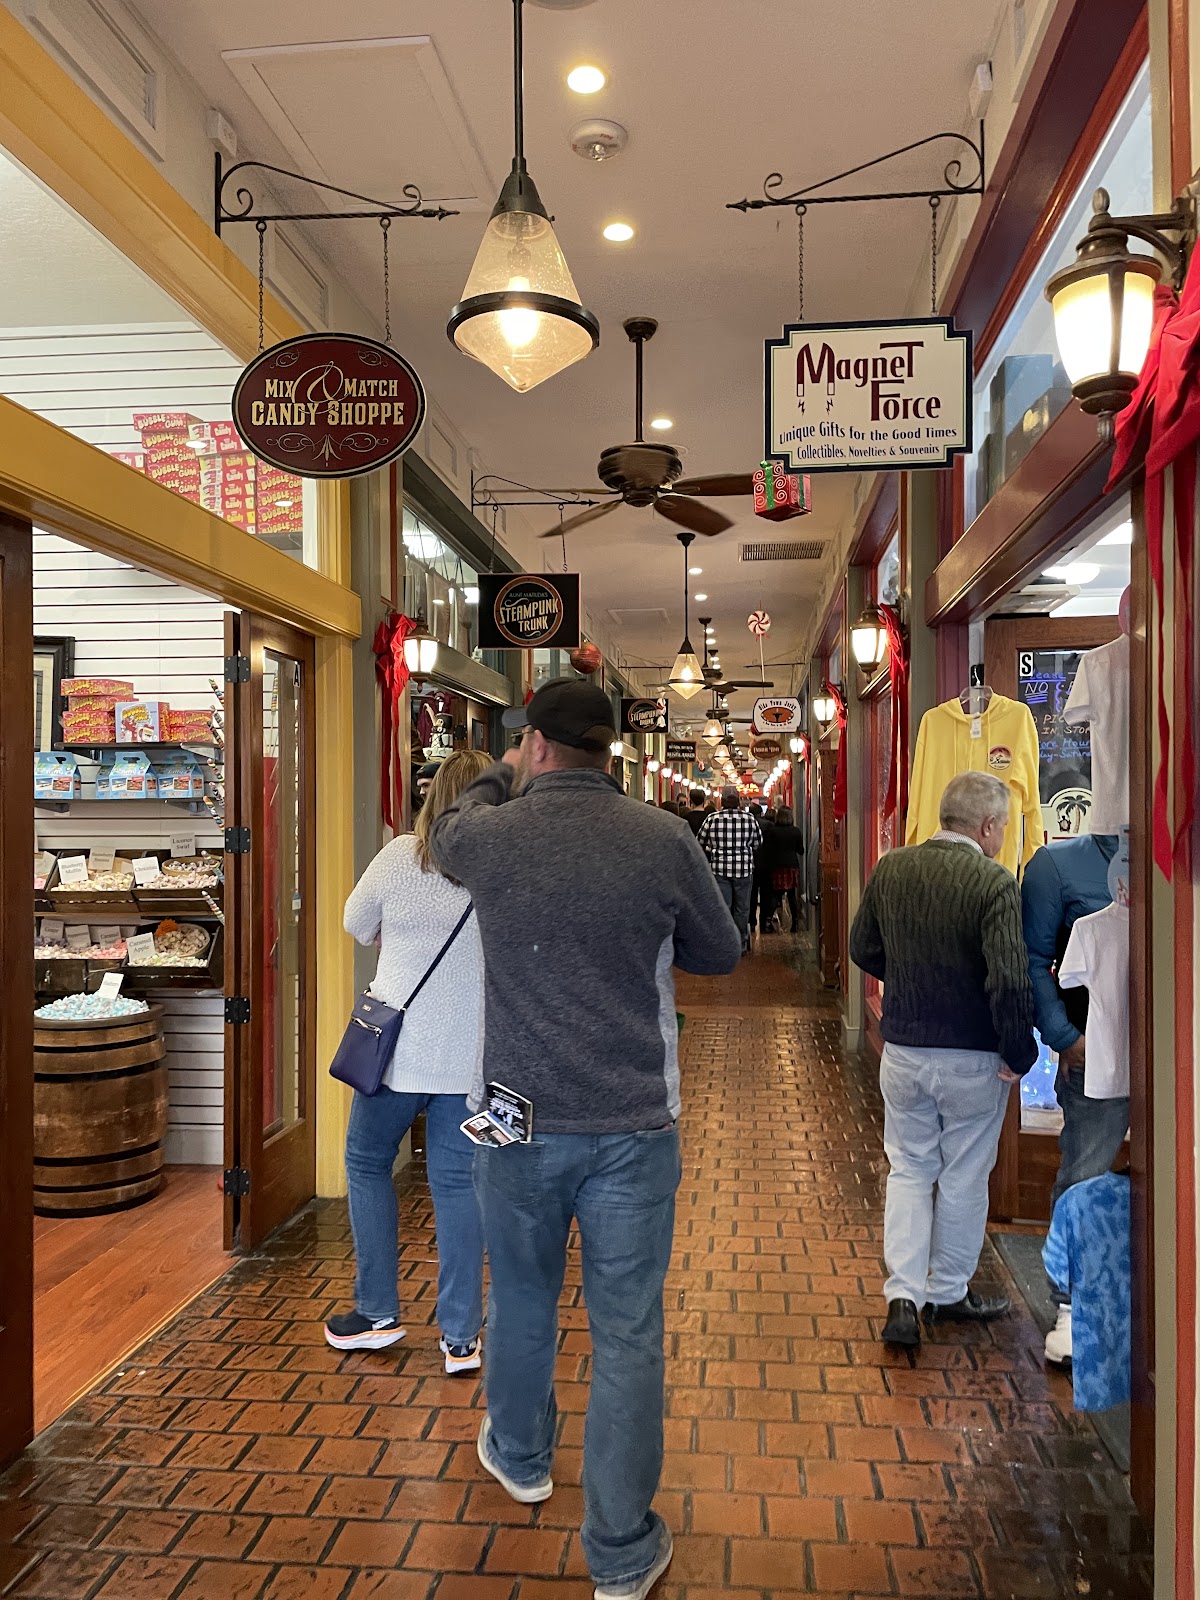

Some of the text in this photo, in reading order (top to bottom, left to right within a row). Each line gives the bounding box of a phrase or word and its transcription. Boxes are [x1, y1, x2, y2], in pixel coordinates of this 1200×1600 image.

[265, 379, 294, 398] MIX
[344, 378, 398, 397] MATCH
[871, 380, 941, 421] Force
[252, 400, 405, 426] CANDY SHOPPE
[138, 414, 183, 429] BUBBLE GUM
[779, 421, 957, 444] Unique Gifts for the Good Times
[151, 448, 196, 462] BUBBLE GUM
[797, 444, 940, 460] Collectibles, Novelties & Souvenirs
[152, 464, 197, 479] BUBBLE GUM
[178, 485, 197, 493] GUM
[261, 475, 289, 490] BUBBLE
[500, 598, 559, 625] STEAMPUNK
[518, 615, 549, 632] TRUNK
[1021, 653, 1032, 675] S
[1025, 681, 1049, 694] NO
[1041, 726, 1057, 735] IN
